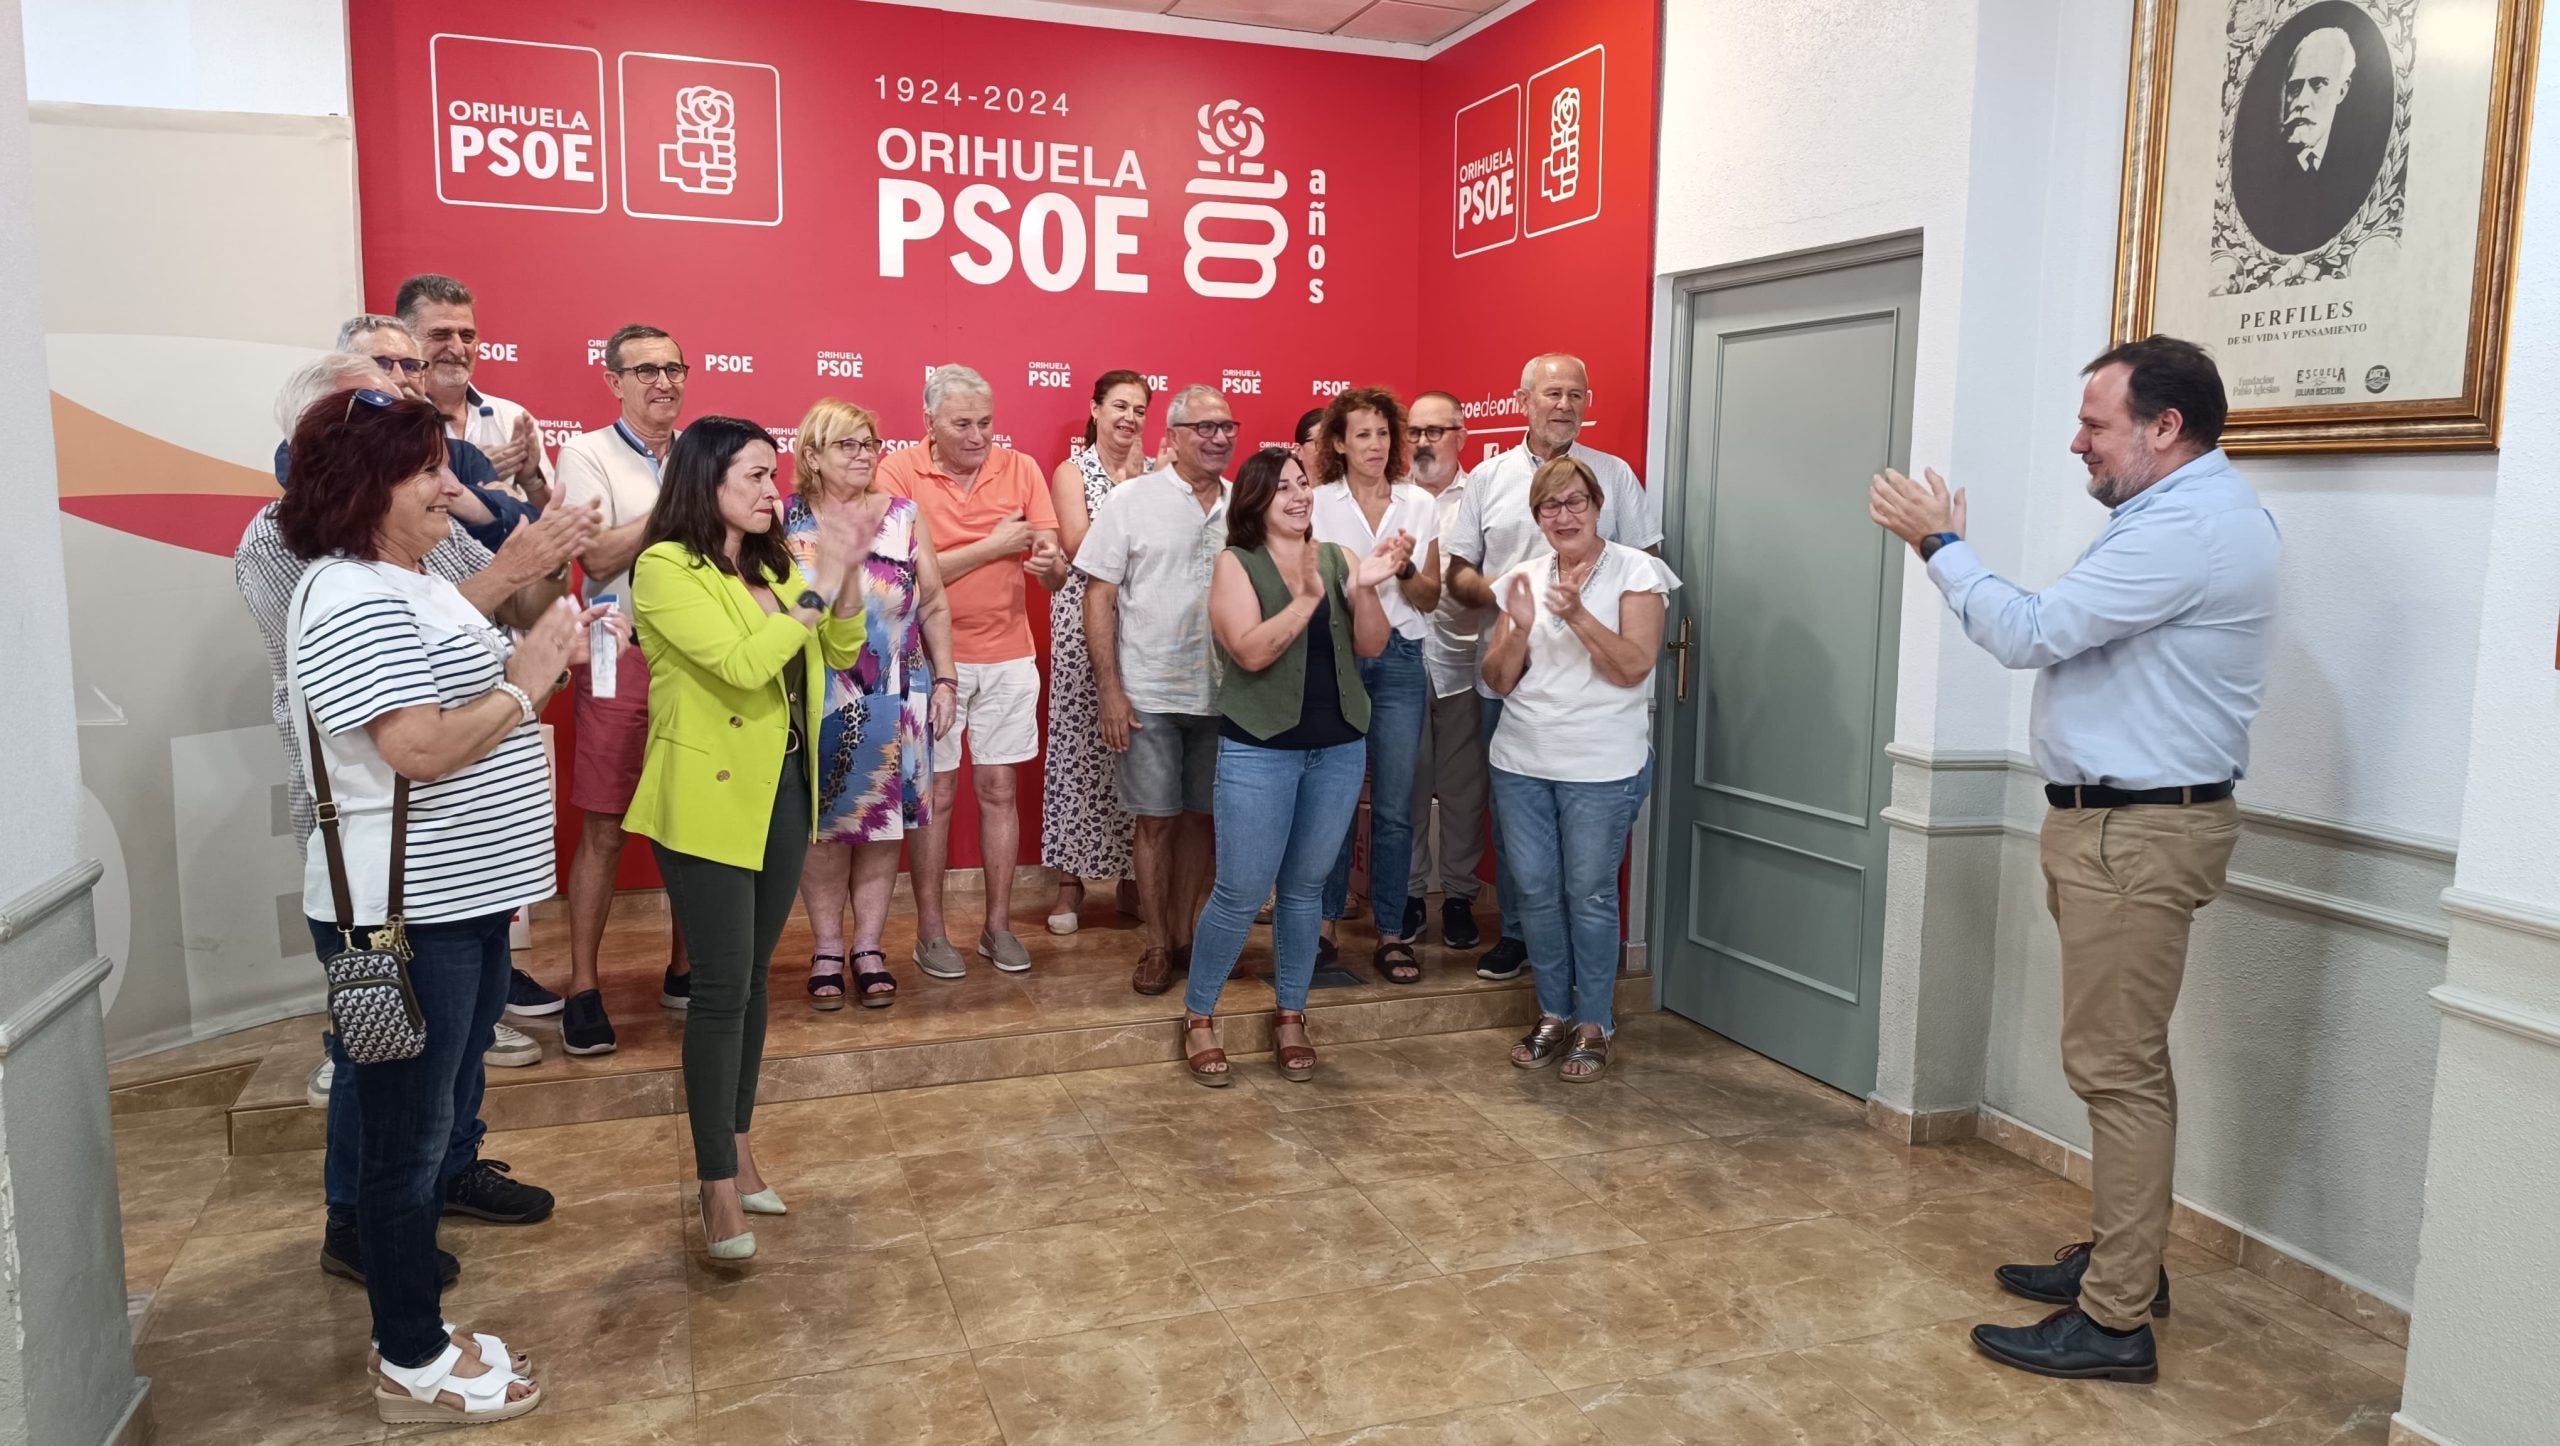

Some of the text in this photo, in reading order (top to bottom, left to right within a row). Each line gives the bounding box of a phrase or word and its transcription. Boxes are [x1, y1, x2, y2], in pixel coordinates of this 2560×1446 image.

[874, 74, 1070, 117] 1924-2024
[448, 100, 590, 131] ORIHUELA
[450, 124, 595, 183] PSOE
[877, 127, 1147, 191] ORIHUELA
[1459, 147, 1514, 184] ORIHUELA
[1458, 168, 1515, 230] PSOE
[878, 177, 1149, 294] PSOE
[2240, 300, 2354, 329] PERFILES
[2227, 323, 2368, 345] DE SU VIDA Y PENSAMIENTO
[475, 342, 519, 362] SOE
[817, 350, 863, 360] ORIHUELA
[705, 354, 754, 373] PSOE
[817, 360, 864, 378] PSOE
[1028, 361, 1071, 370] ORIHUELA
[1222, 369, 1262, 378] ORIHUELA
[1028, 370, 1072, 388] PSOE
[1222, 377, 1262, 394] PSOE
[2296, 367, 2346, 384] ESCUELA
[539, 419, 583, 429] RIHUELA
